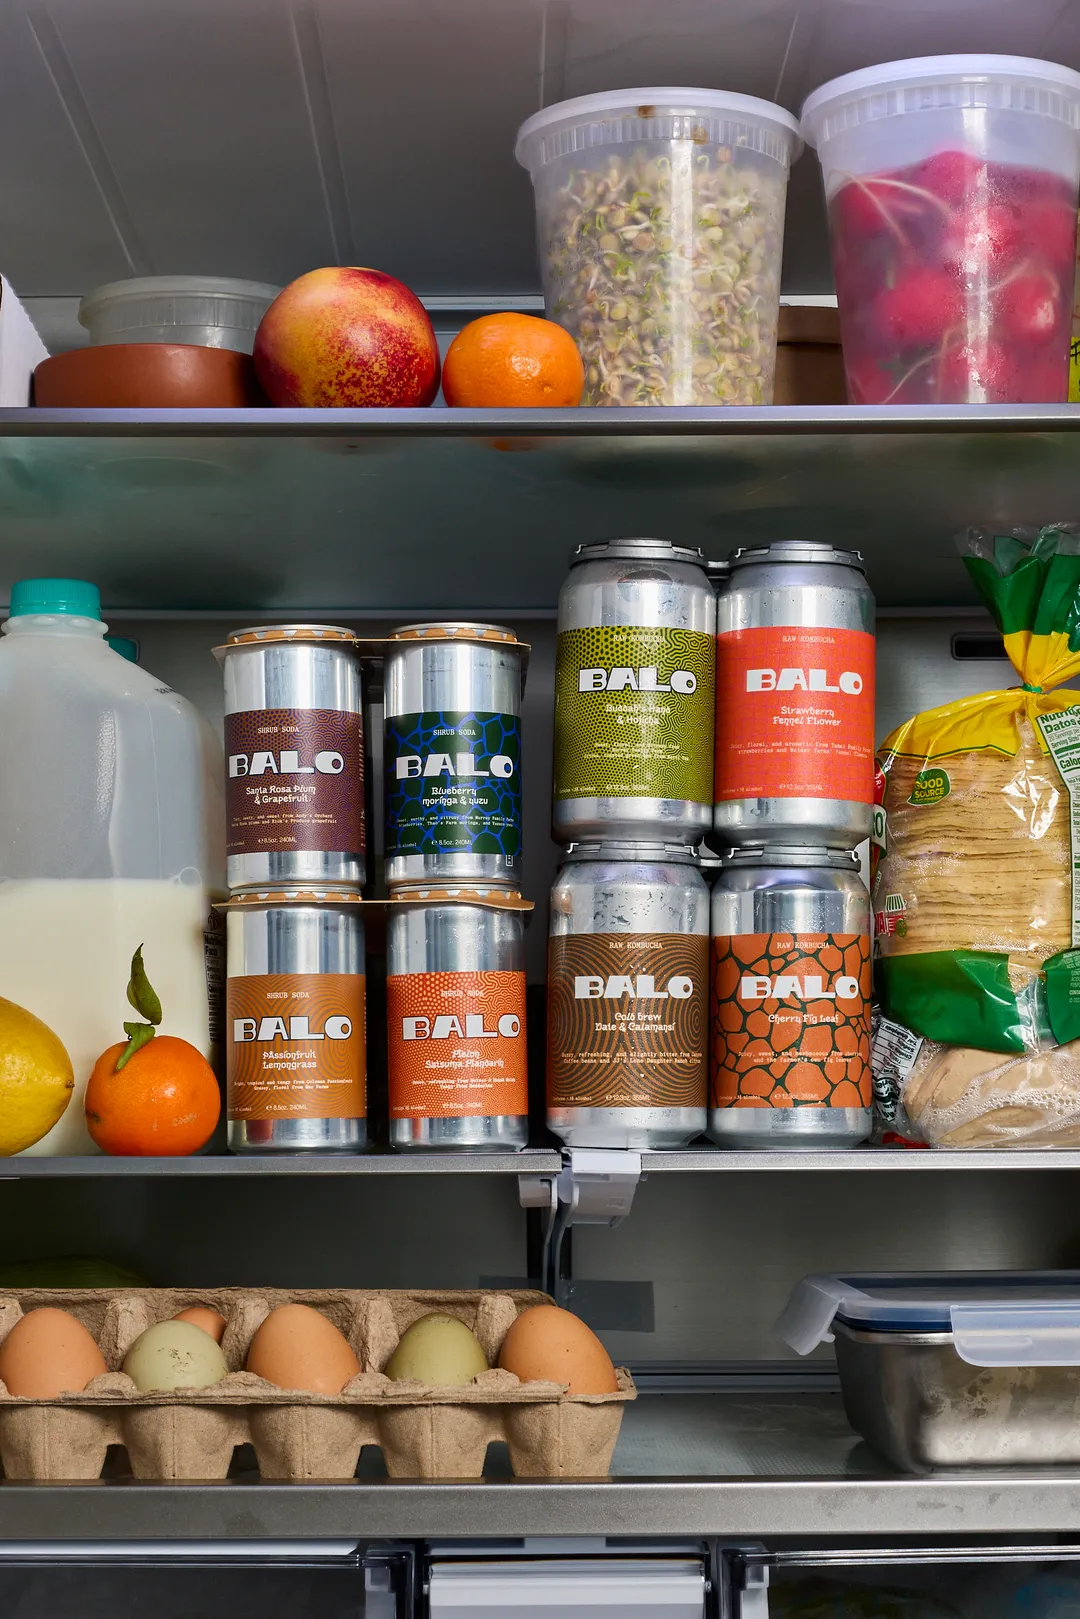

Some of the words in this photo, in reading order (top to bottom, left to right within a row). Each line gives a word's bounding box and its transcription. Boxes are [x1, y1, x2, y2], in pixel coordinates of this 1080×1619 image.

[800, 635, 835, 644] KOMBUCHA
[578, 666, 697, 694] BALO
[746, 668, 863, 695] BALO
[781, 706, 835, 717] Strawberry
[617, 715, 624, 724] &
[773, 716, 804, 726] Fennel
[1043, 718, 1077, 734] Datos
[228, 750, 344, 778] BALO
[396, 752, 513, 779] BALO
[915, 777, 943, 790] GOOD
[246, 787, 267, 796] Santa
[270, 785, 291, 794] Rosa
[293, 785, 316, 795] Plum
[431, 787, 476, 796] Blueberry
[915, 788, 945, 799] SOURCE
[422, 797, 458, 806] moringa
[460, 797, 467, 805] &
[627, 941, 662, 949] KOMBUCHA
[795, 942, 829, 950] KOMBUCHA
[575, 975, 693, 999] BALO
[741, 976, 859, 999] BALO
[292, 991, 309, 999] SODA
[615, 1012, 635, 1021] Cold
[637, 1012, 662, 1021] brew
[768, 1014, 801, 1024] Cherry
[803, 1014, 817, 1024] Fig
[820, 1014, 839, 1023] Leaf
[234, 1015, 352, 1042] BALO
[402, 1014, 520, 1040] BALO
[595, 1022, 616, 1031] Date
[619, 1022, 626, 1032] &
[628, 1022, 676, 1033] Calamansi
[263, 1061, 317, 1070] Lemongrass
